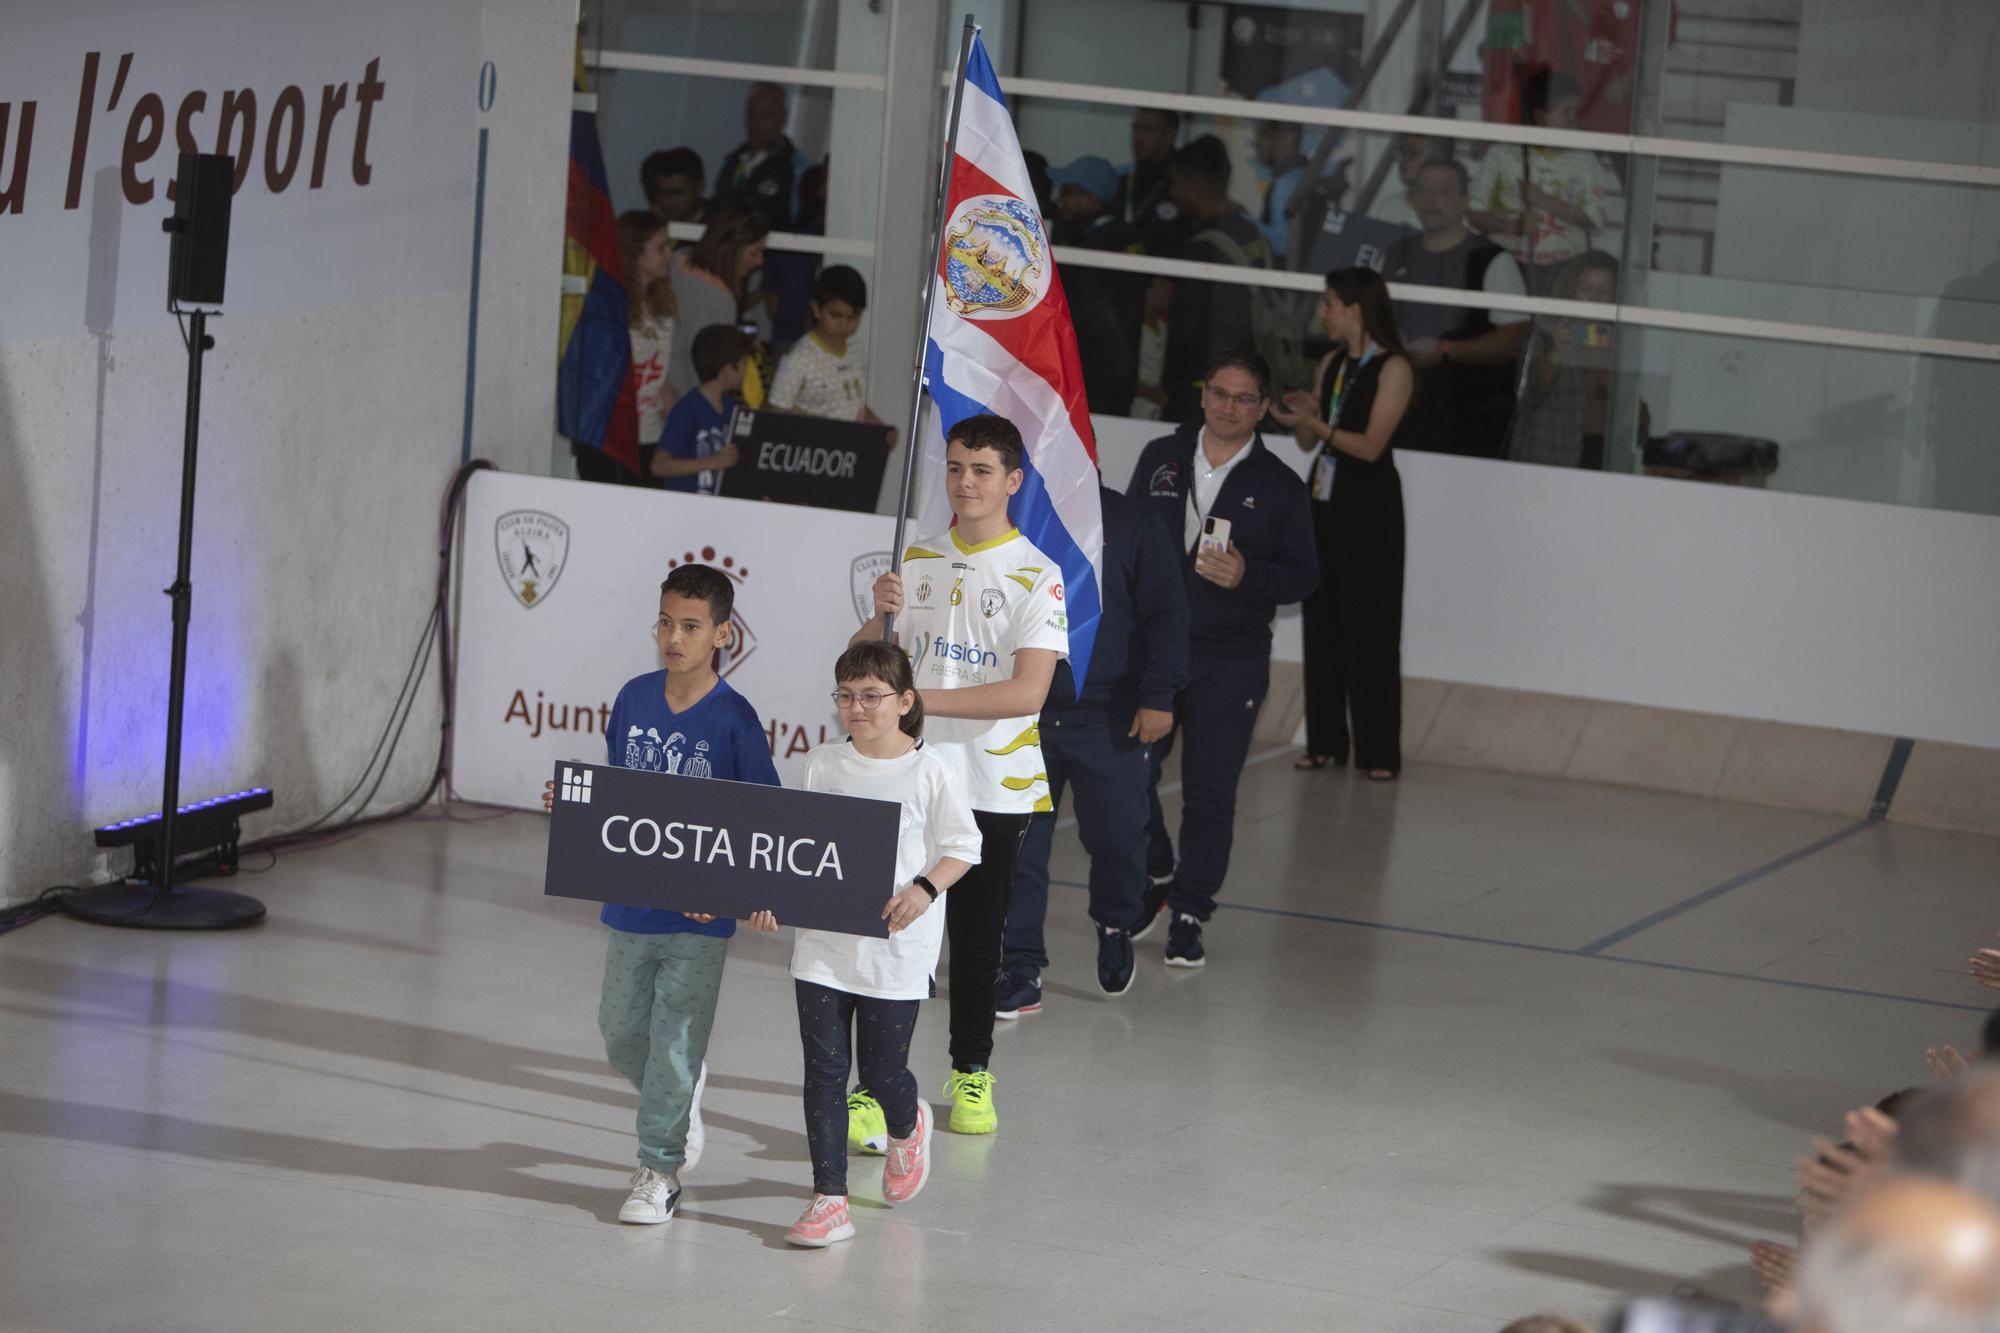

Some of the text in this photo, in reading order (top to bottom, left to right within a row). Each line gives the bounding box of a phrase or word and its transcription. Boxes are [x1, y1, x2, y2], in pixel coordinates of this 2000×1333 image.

[64, 51, 386, 210] l'esport
[757, 441, 858, 479] ECUADOR
[933, 636, 997, 668] fusión
[601, 814, 845, 881] COSTA RICA
